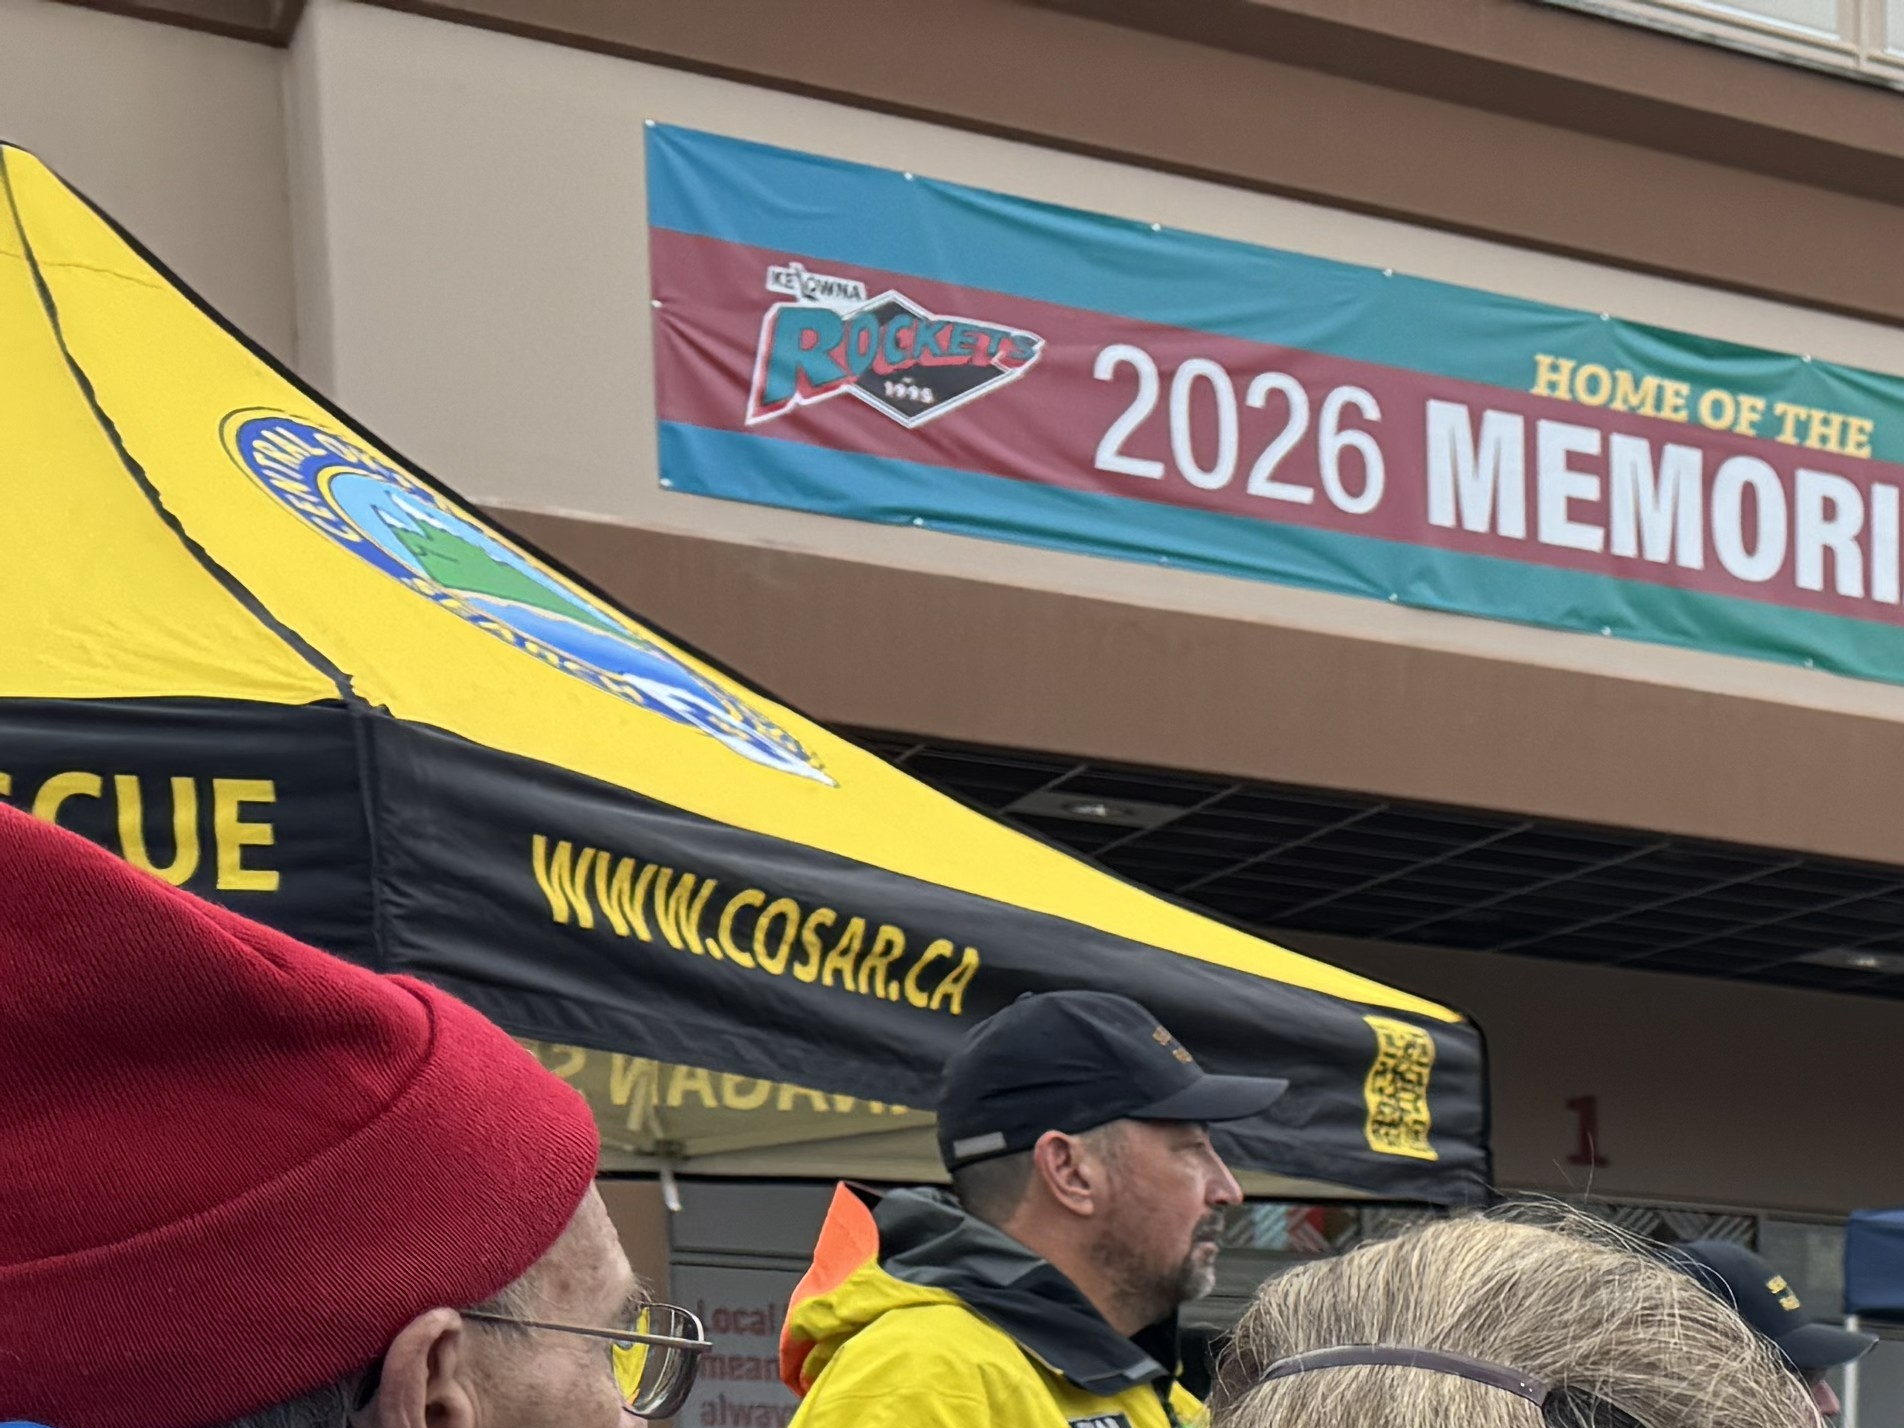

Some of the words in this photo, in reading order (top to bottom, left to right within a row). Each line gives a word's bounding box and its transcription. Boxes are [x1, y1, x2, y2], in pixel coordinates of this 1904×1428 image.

[756, 306, 1035, 404] ROCKETS
[1531, 353, 1688, 424] HOME
[1698, 388, 1763, 436] OF
[1773, 401, 1873, 459] THE
[1092, 344, 1386, 515] 2026
[531, 834, 979, 1015] WWW.COSAR.CA
[1564, 1095, 1608, 1168] 1
